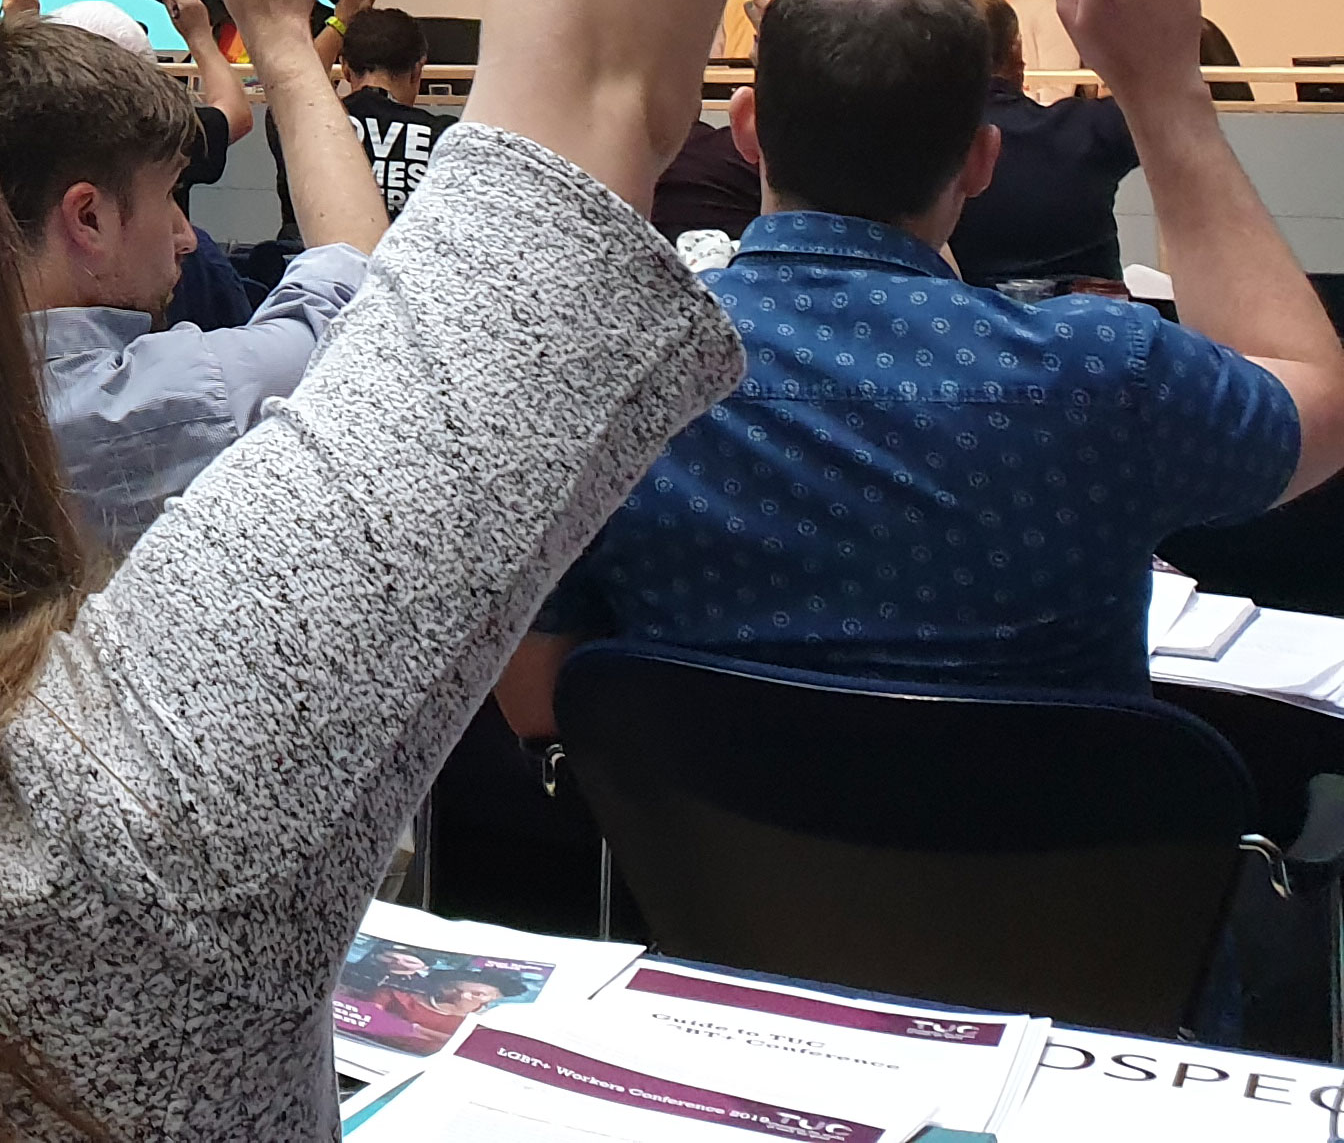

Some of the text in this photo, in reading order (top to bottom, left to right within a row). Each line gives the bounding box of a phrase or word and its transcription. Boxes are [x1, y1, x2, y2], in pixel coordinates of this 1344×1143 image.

[912, 1020, 980, 1035] TUC
[769, 1033, 826, 1048] TUC
[496, 1047, 551, 1070] LGBT+
[555, 1065, 626, 1093] Workers
[628, 1087, 726, 1115] Conference
[776, 1112, 853, 1136] TUC
